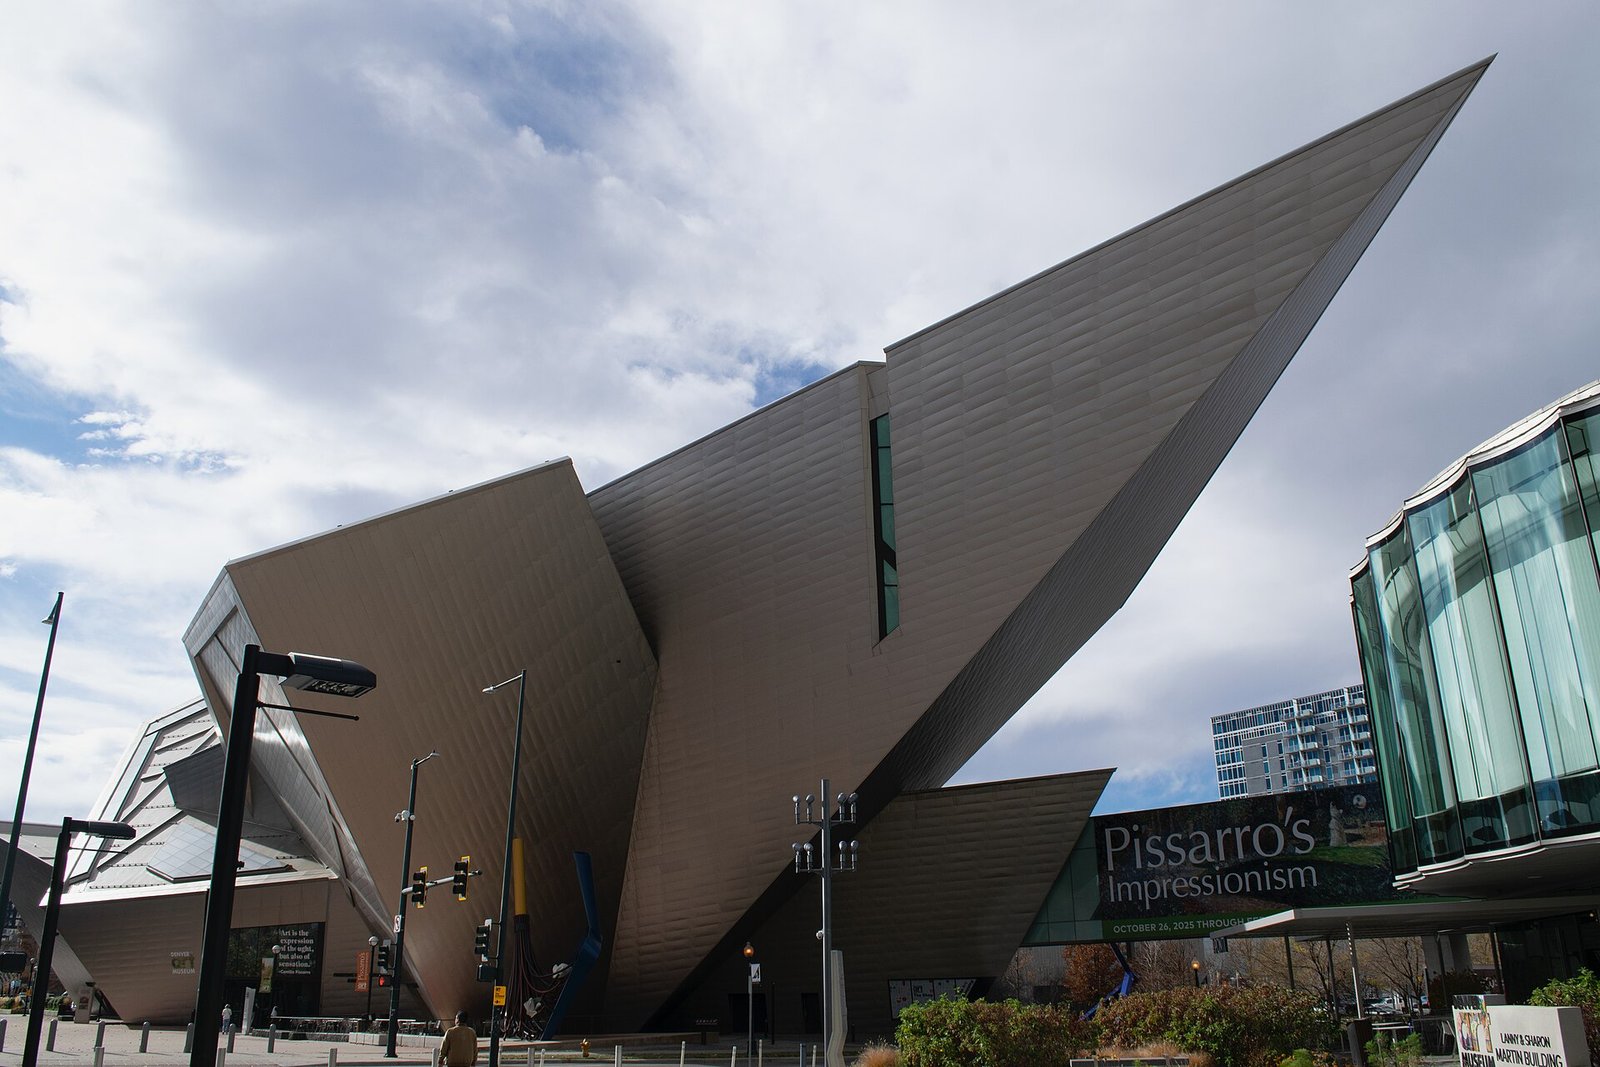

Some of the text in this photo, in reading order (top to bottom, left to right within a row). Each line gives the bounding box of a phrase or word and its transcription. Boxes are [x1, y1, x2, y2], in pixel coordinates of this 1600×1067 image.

[1104, 806, 1315, 871] Pissarro's
[1108, 861, 1318, 910] Impressionism
[292, 929, 298, 937] is
[299, 929, 309, 937] the
[1113, 923, 1156, 934] OCTOBER
[1158, 923, 1171, 932] 26,
[1173, 920, 1195, 931] 2025
[1196, 917, 1244, 929] THROUGH
[280, 937, 314, 945] expression
[279, 952, 310, 960] but also of
[1500, 1032, 1551, 1048] LANNY & SHARON
[1461, 1052, 1495, 1067] MUSEUM
[1495, 1047, 1563, 1067] MARTIN BUILDING
